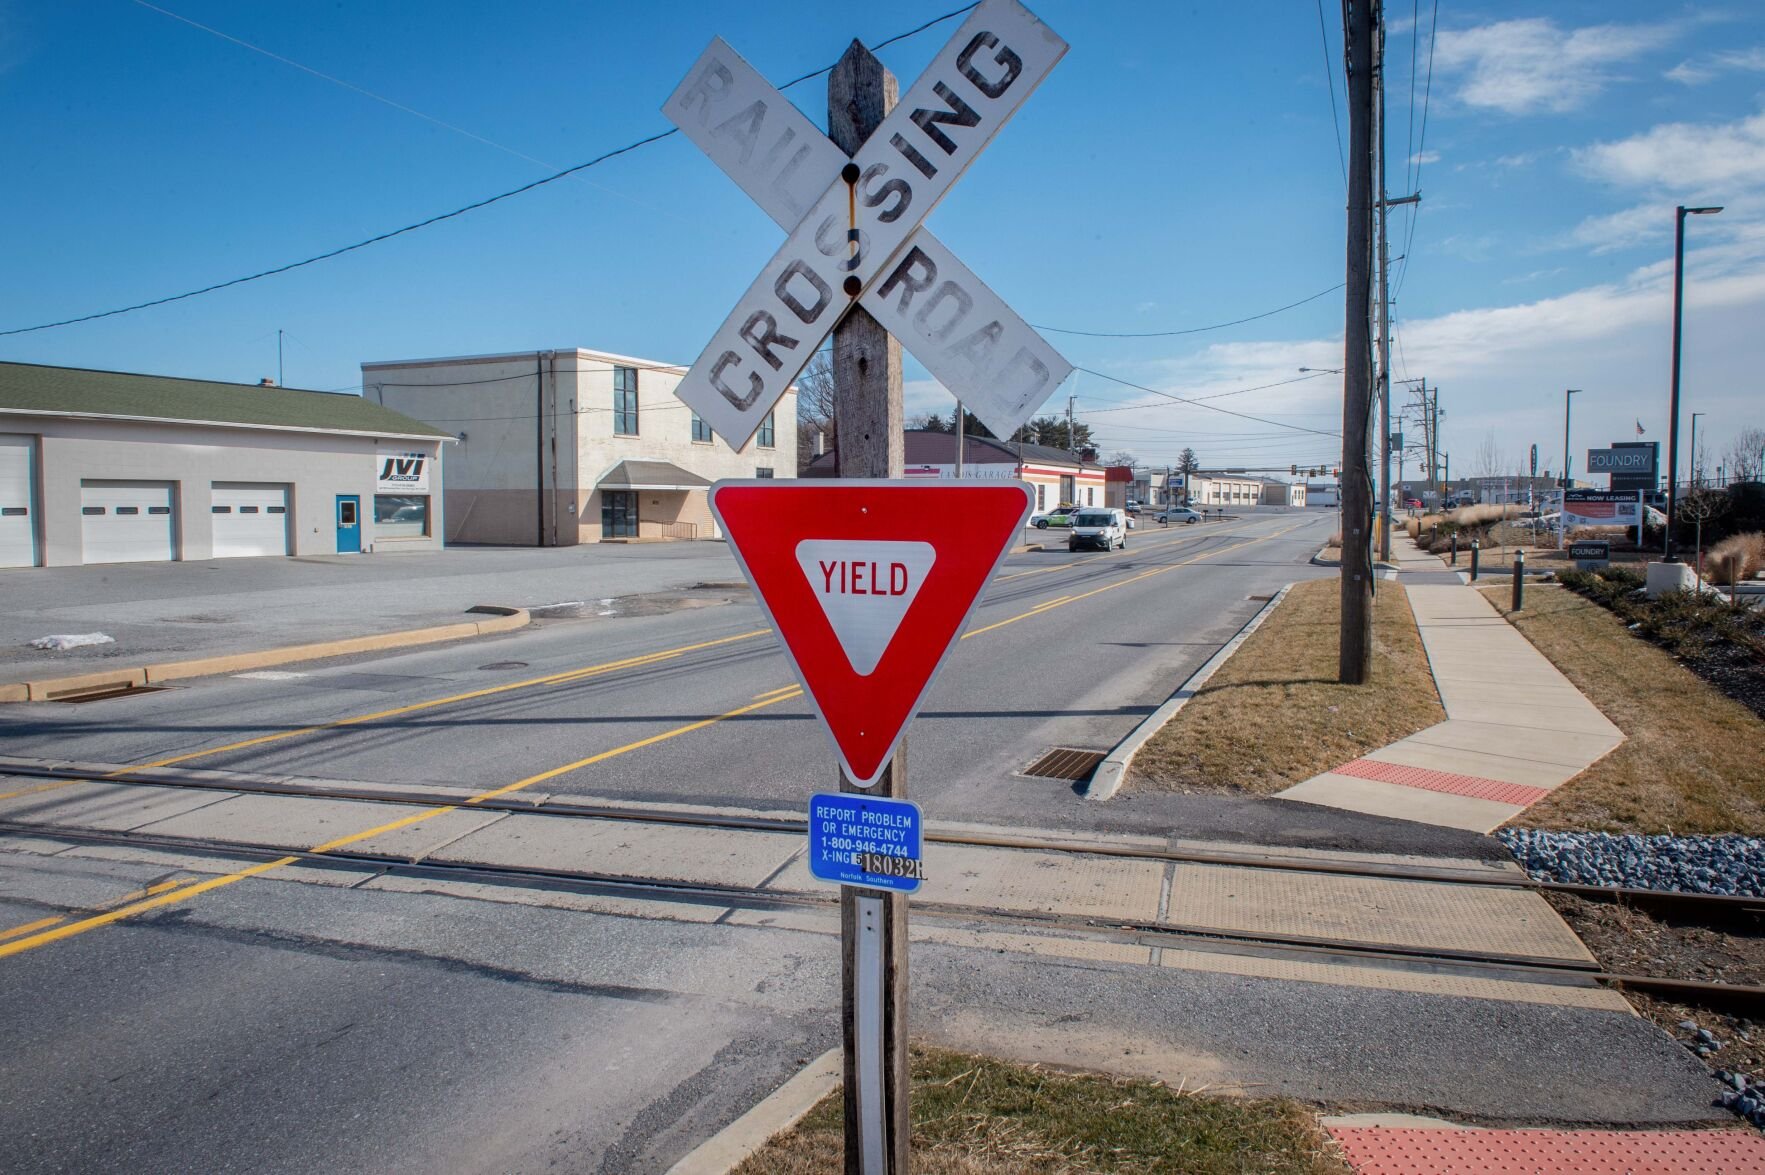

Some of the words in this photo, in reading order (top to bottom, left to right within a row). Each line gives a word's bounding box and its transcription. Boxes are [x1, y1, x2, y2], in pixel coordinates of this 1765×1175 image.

[708, 30, 1023, 412] CROSSING
[679, 57, 812, 222] RAIL
[877, 245, 1051, 416] ROAD
[1590, 454, 1648, 467] FOUNDRY
[975, 471, 1013, 479] GARAGE
[1571, 548, 1605, 556] FOUNDRY
[819, 560, 908, 596] YIELD
[816, 806, 856, 822] REPORT
[861, 811, 912, 828] PROBLEM
[822, 821, 836, 834] OR
[842, 823, 906, 842] EMERGENCY
[821, 836, 908, 858] 1-800-946-4744
[822, 849, 850, 864] X-ING
[840, 872, 862, 881] Norfolk
[866, 874, 894, 886] Southern
